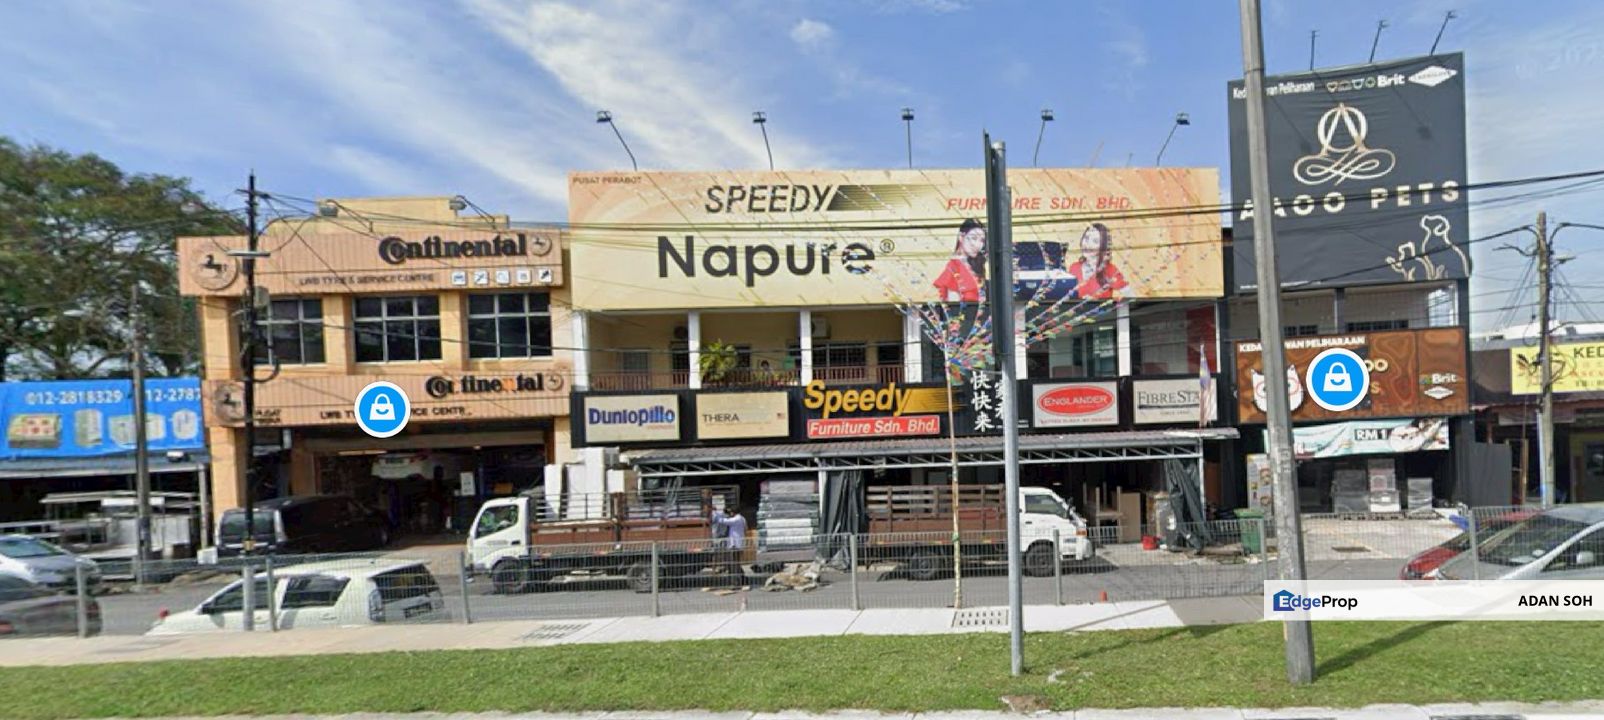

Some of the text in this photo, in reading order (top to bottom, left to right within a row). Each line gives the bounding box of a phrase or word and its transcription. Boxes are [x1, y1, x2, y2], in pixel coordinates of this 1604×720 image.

[1377, 74, 1405, 87] Brit
[572, 176, 641, 184] PUSAT PERABOT
[705, 185, 831, 213] SPEEDY
[1050, 197, 1088, 210] SDN.
[1096, 196, 1134, 209] BHD.
[1371, 180, 1459, 209] PETS
[379, 234, 527, 265] Continental
[357, 274, 396, 284] SERVICE
[1431, 373, 1457, 384] Brit
[804, 379, 910, 420] Speedy
[970, 370, 995, 433] 快快来
[1044, 395, 1108, 407] ENGLANDER
[588, 405, 676, 427] Dunlopillo
[810, 418, 937, 435] Furniture Sdn. Bhd.
